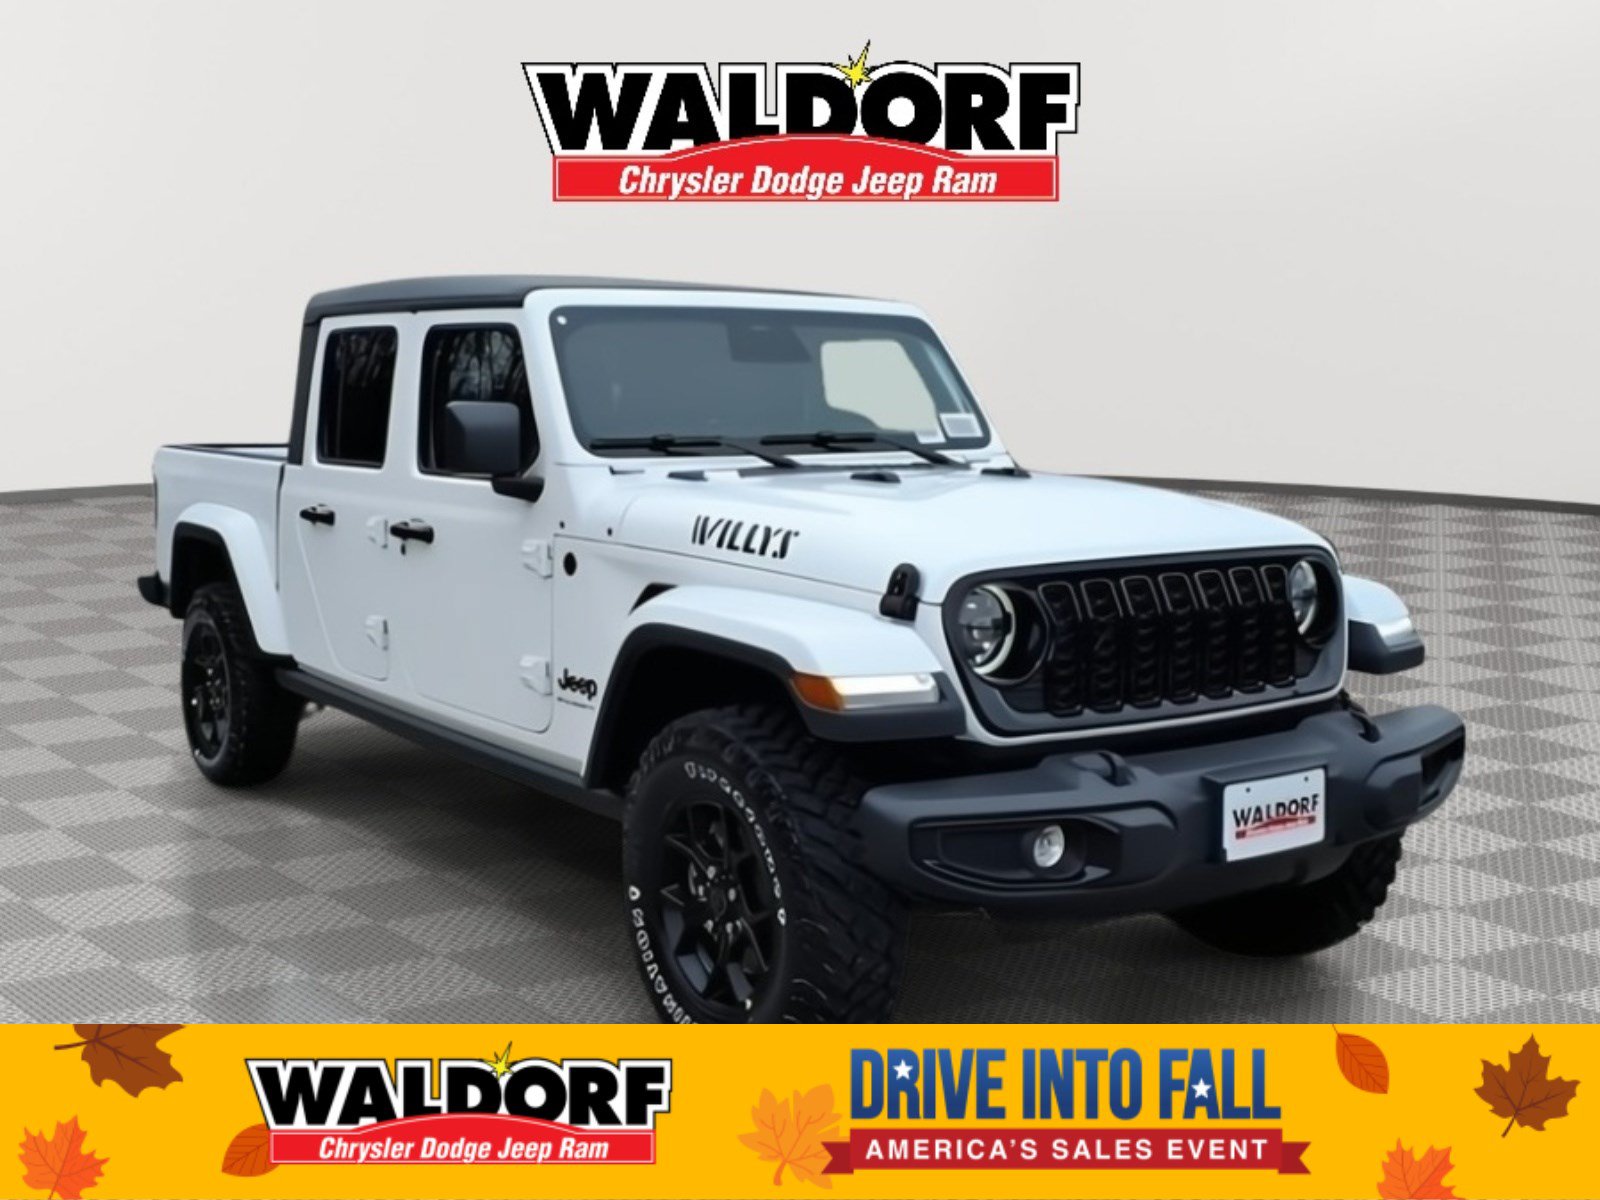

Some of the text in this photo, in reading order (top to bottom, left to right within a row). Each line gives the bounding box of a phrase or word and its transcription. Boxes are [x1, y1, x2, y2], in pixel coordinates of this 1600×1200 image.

[691, 514, 800, 560] WILLYS
[557, 668, 598, 700] Jeep
[1232, 793, 1319, 829] WALDORF
